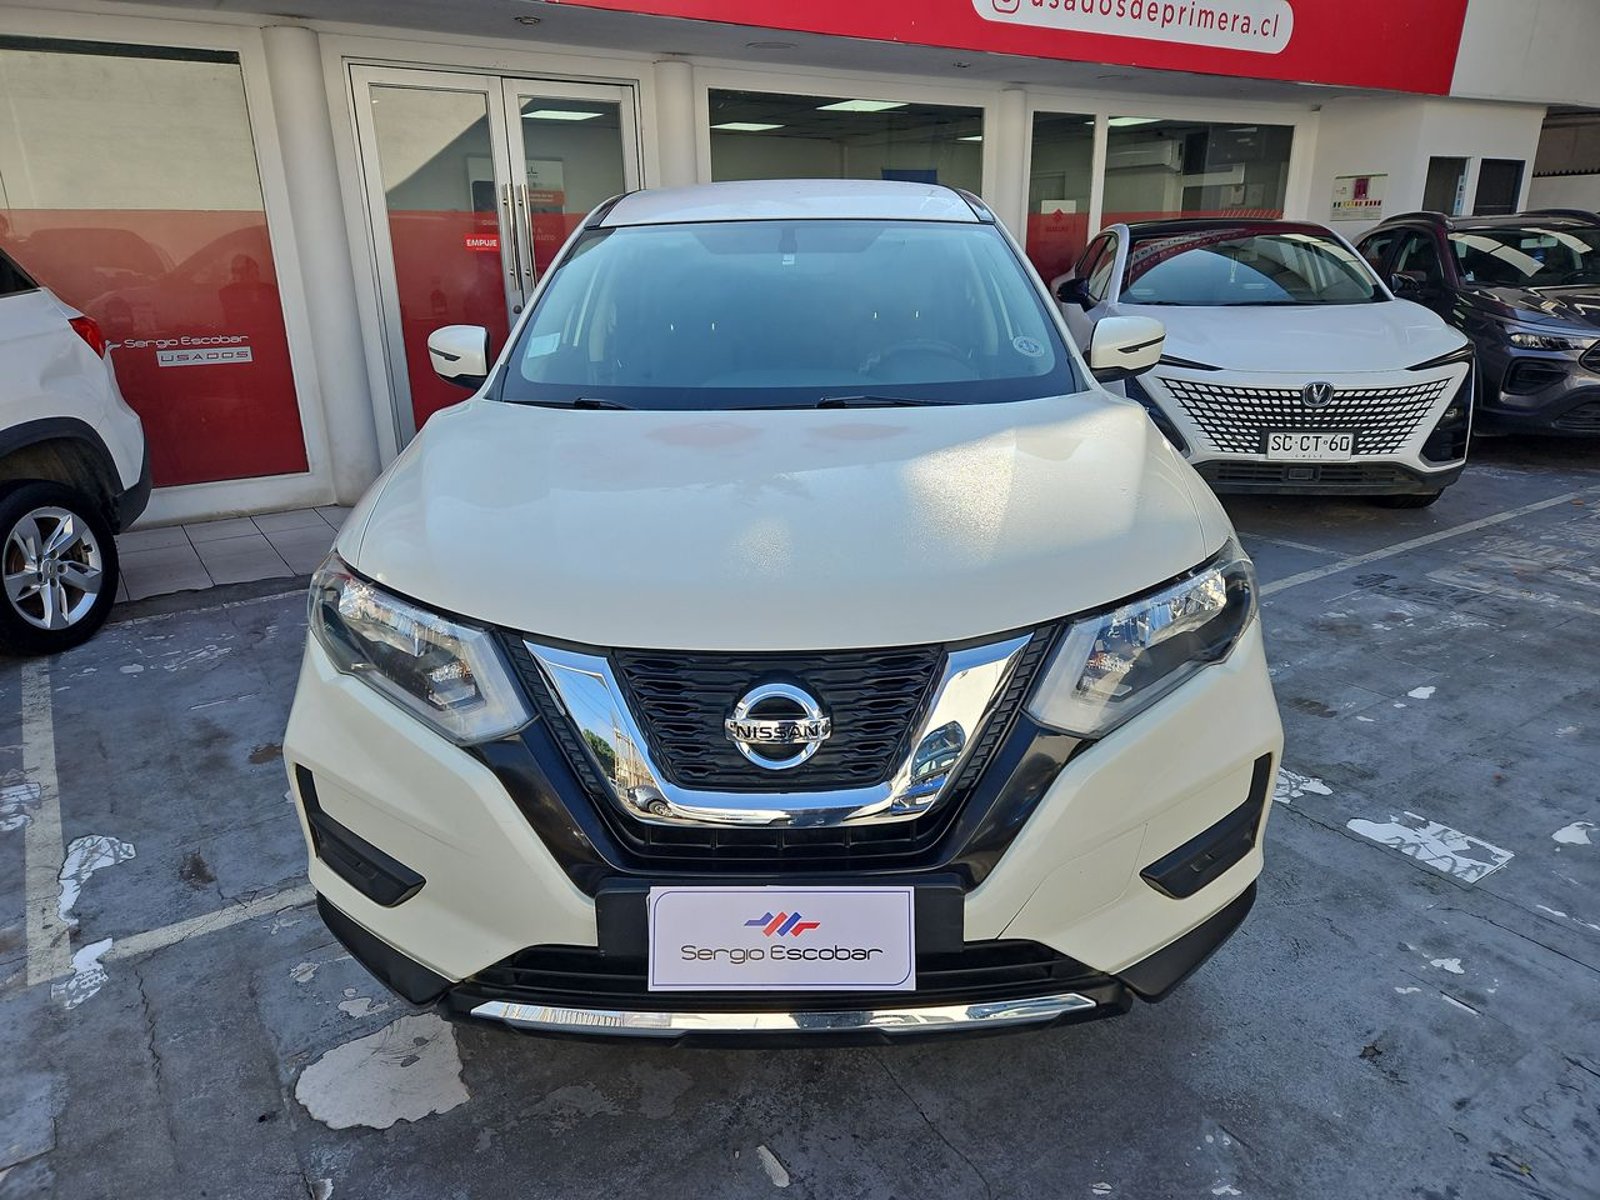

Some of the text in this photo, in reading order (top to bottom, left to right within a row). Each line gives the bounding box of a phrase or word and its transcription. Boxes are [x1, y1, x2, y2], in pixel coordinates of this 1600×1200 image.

[466, 239, 497, 247] EMPUJE
[180, 334, 249, 346] Escobar
[160, 350, 249, 362] USADOS
[736, 724, 819, 739] NISSAN
[680, 944, 884, 965] Sergio Escobar
